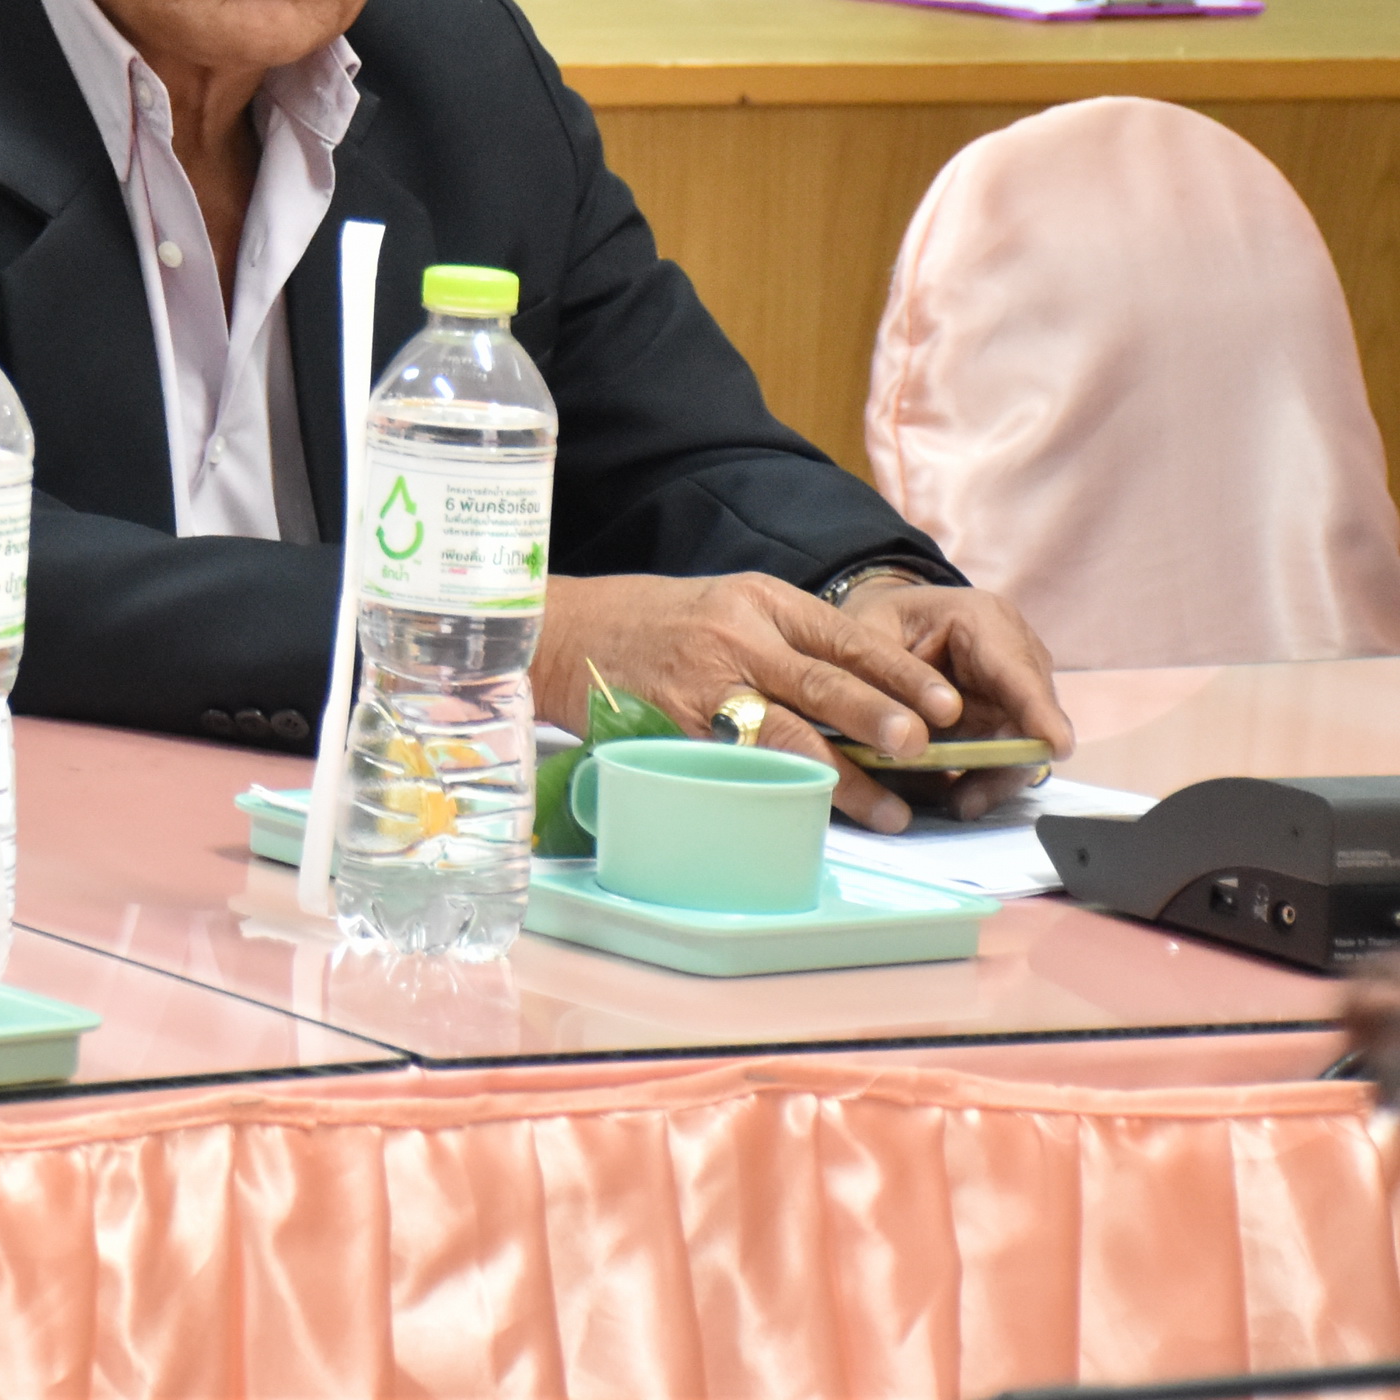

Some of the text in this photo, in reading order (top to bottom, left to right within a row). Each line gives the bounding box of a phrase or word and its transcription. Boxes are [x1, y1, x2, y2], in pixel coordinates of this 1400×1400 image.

[445, 496, 541, 514] 6 พันครัวเรือน
